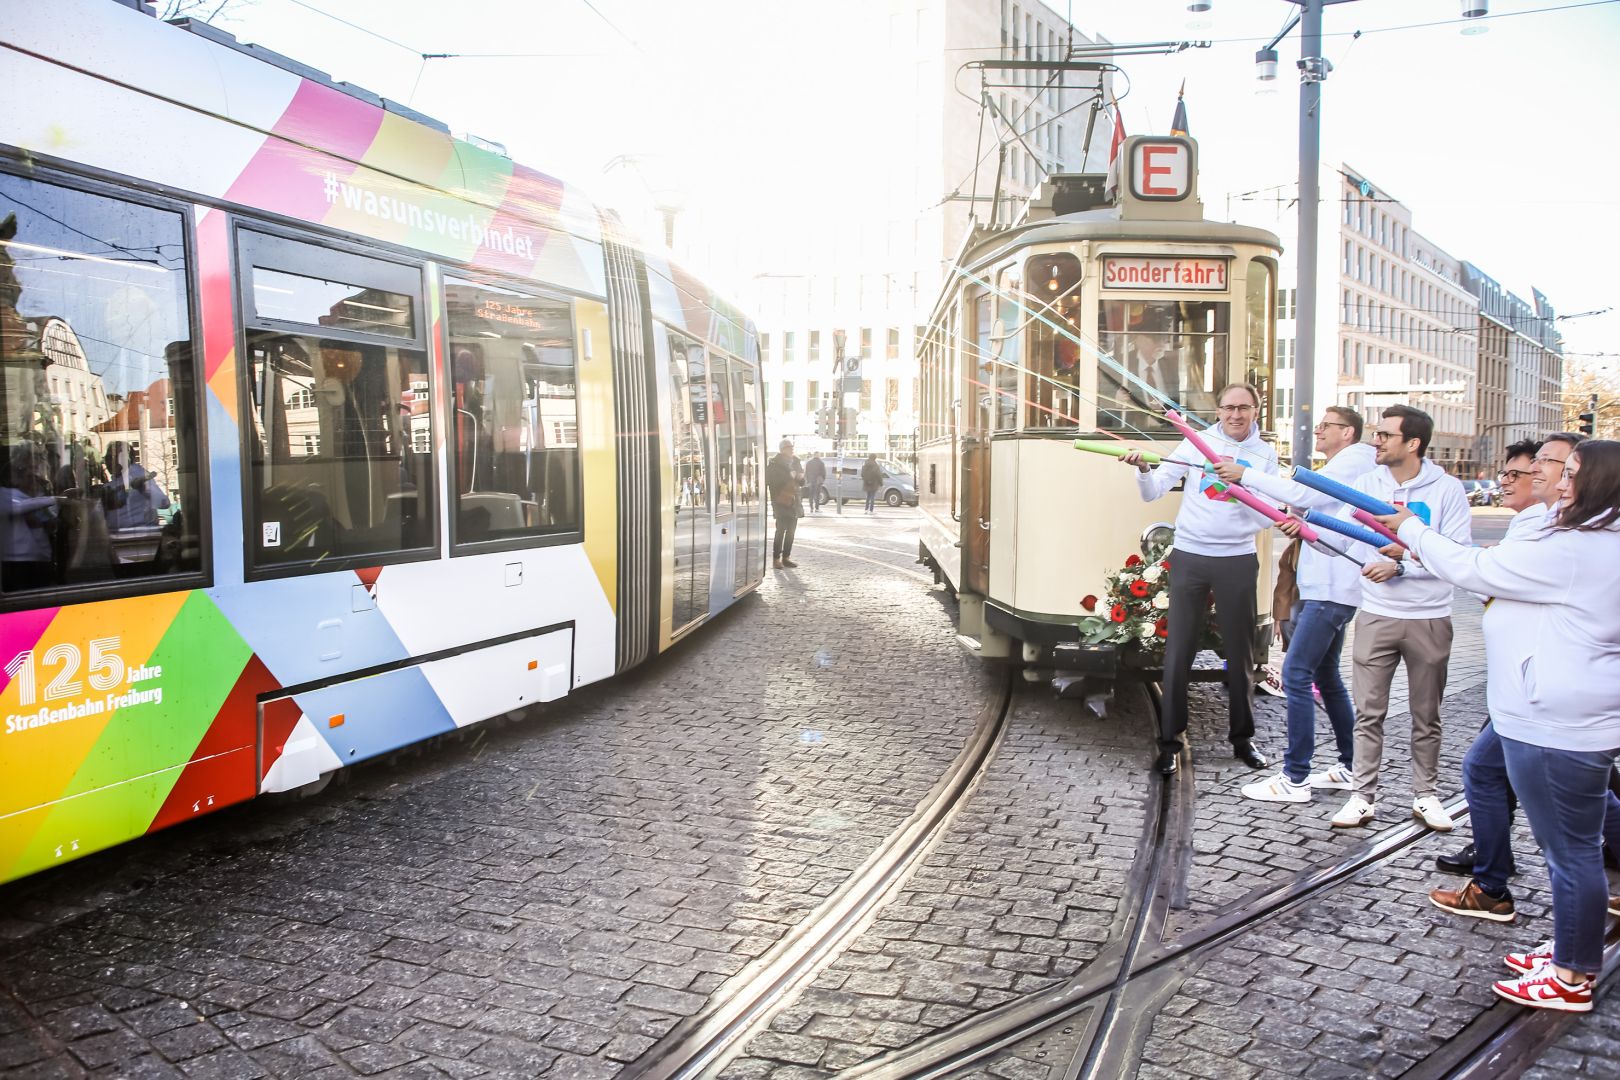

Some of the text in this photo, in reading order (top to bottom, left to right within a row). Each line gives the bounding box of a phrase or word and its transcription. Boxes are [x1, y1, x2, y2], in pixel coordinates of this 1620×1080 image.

[1143, 146, 1178, 195] E
[324, 171, 534, 260] #wasunsverbindet
[1106, 260, 1224, 285] Sonderfahrt
[485, 300, 502, 311] 125
[4, 636, 162, 706] 125 Jahre
[5, 687, 163, 734] Straßenbahn Freiburg
